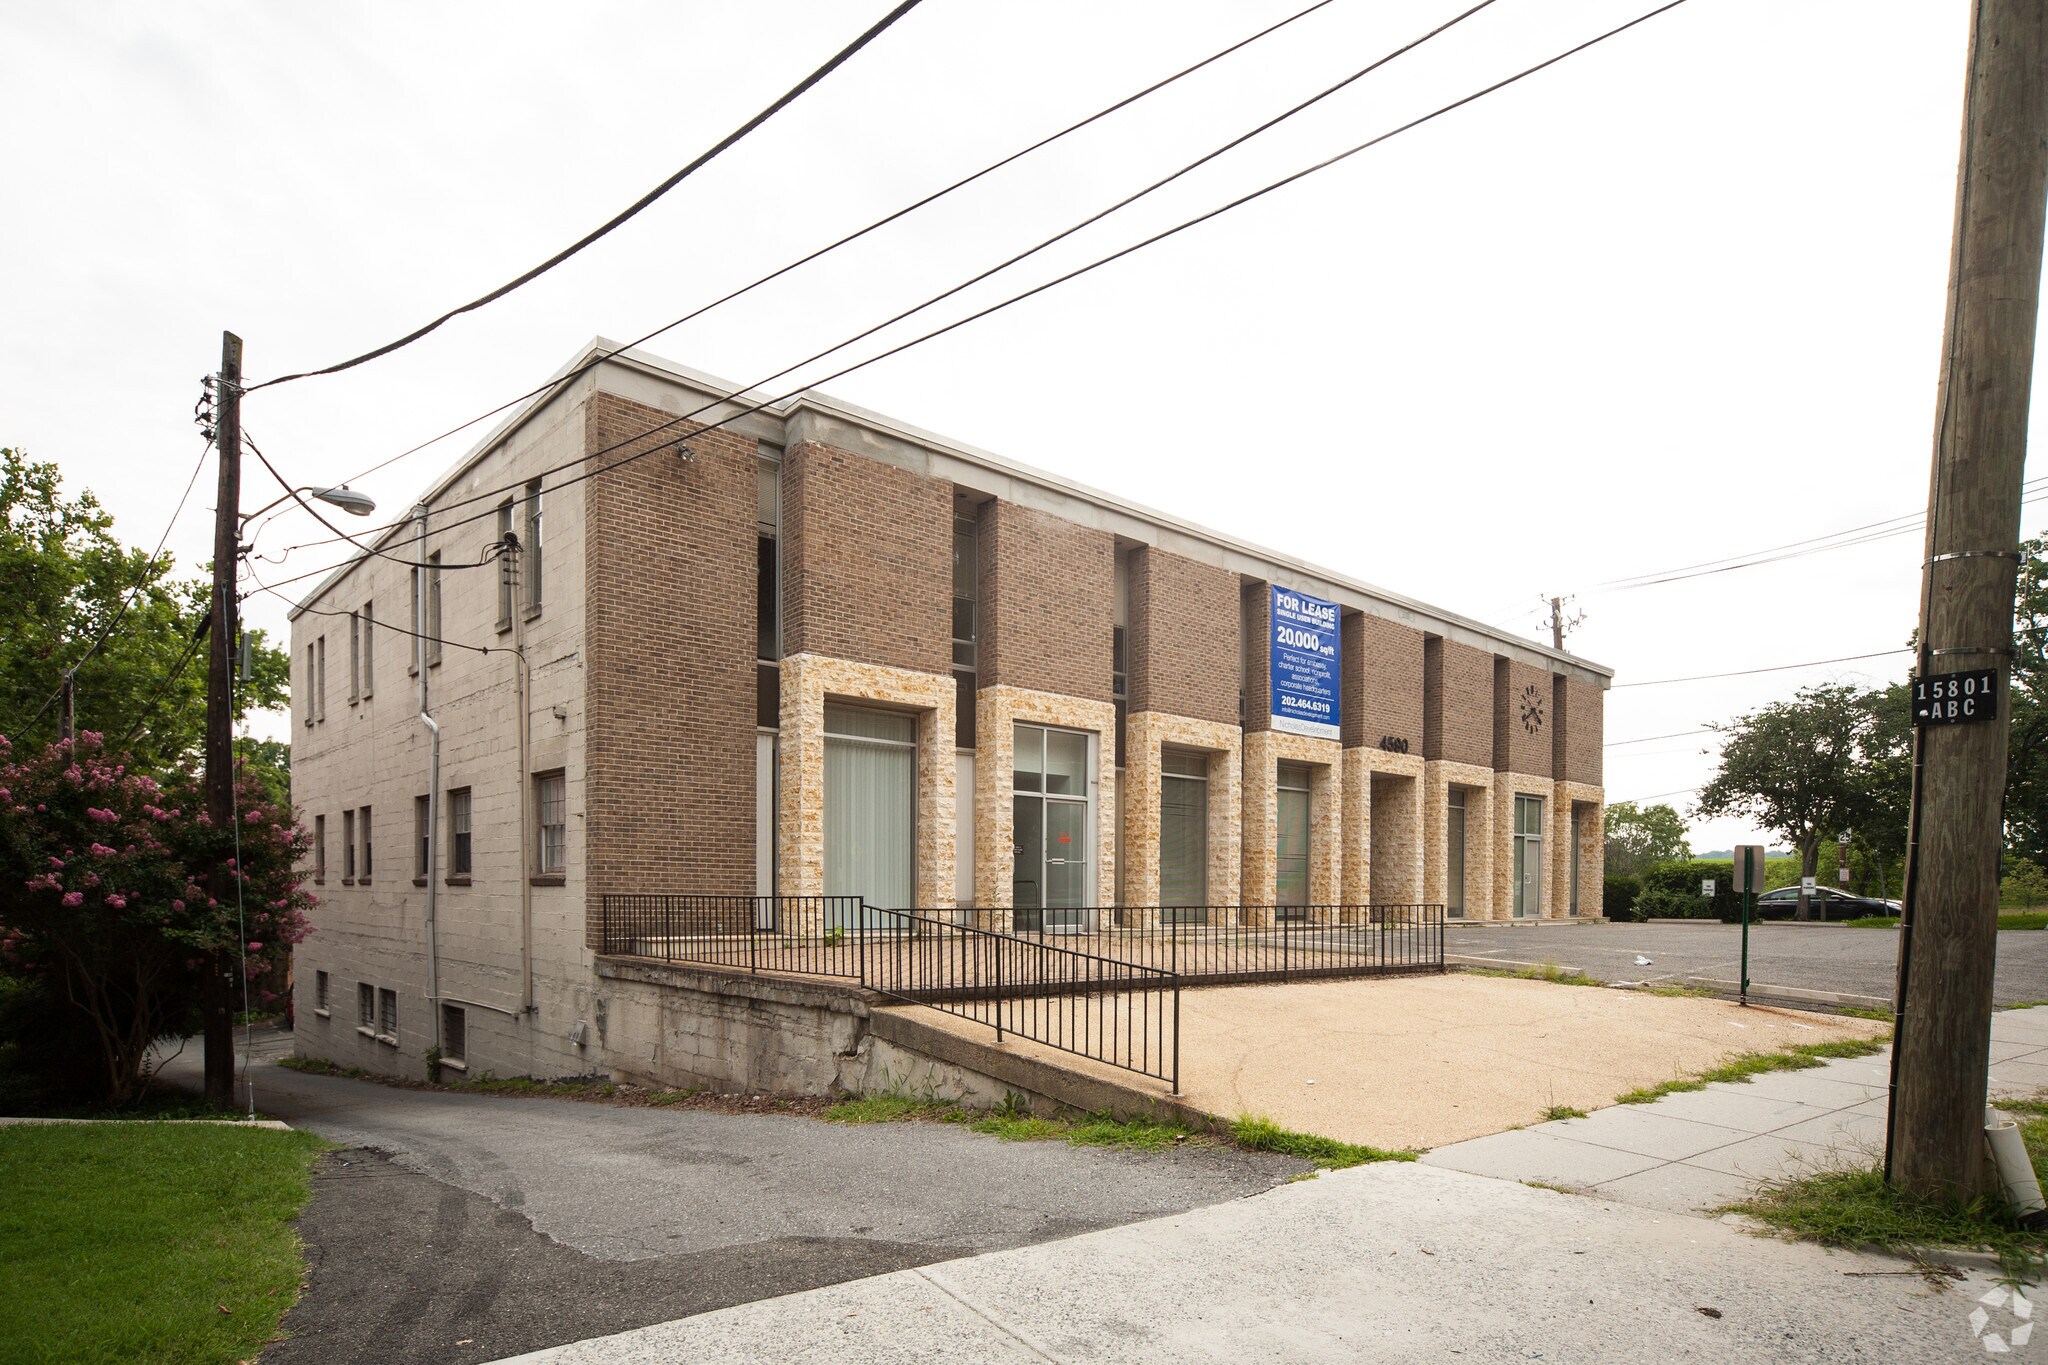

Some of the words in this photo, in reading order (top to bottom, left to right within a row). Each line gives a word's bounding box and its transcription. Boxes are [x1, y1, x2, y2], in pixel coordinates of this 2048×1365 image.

[1277, 593, 1299, 612] FOR
[1302, 600, 1335, 622] LEASE
[1276, 608, 1296, 619] SINGLE
[1297, 614, 1311, 624] USER
[1311, 618, 1335, 630] BUILDING
[1277, 625, 1319, 651] 20,000
[1278, 661, 1294, 670] charter
[1283, 652, 1299, 663] Perfect
[1280, 680, 1302, 690] corporate
[1303, 684, 1331, 696] headquarters
[1917, 676, 1990, 700] 15801
[1281, 695, 1330, 713] 202.464.6319
[1931, 698, 1975, 719] ABC
